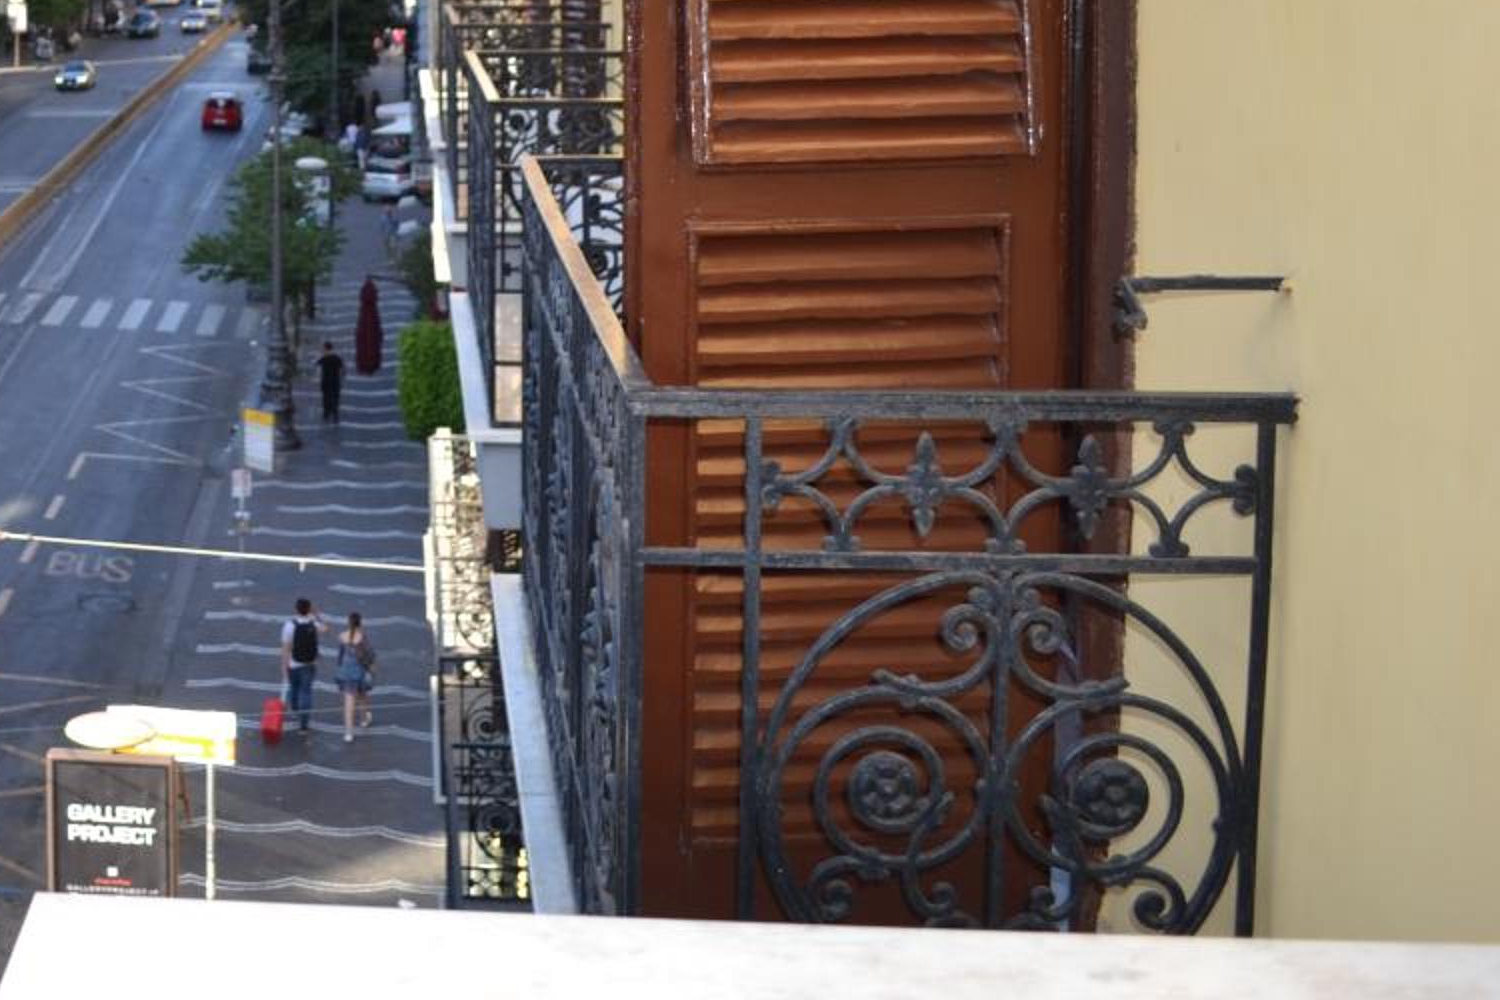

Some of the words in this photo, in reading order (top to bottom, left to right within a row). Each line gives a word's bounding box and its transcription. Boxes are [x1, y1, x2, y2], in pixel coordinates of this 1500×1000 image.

[46, 550, 132, 582] BUS
[67, 803, 156, 825] GALLERY
[67, 823, 157, 846] PROJECT
